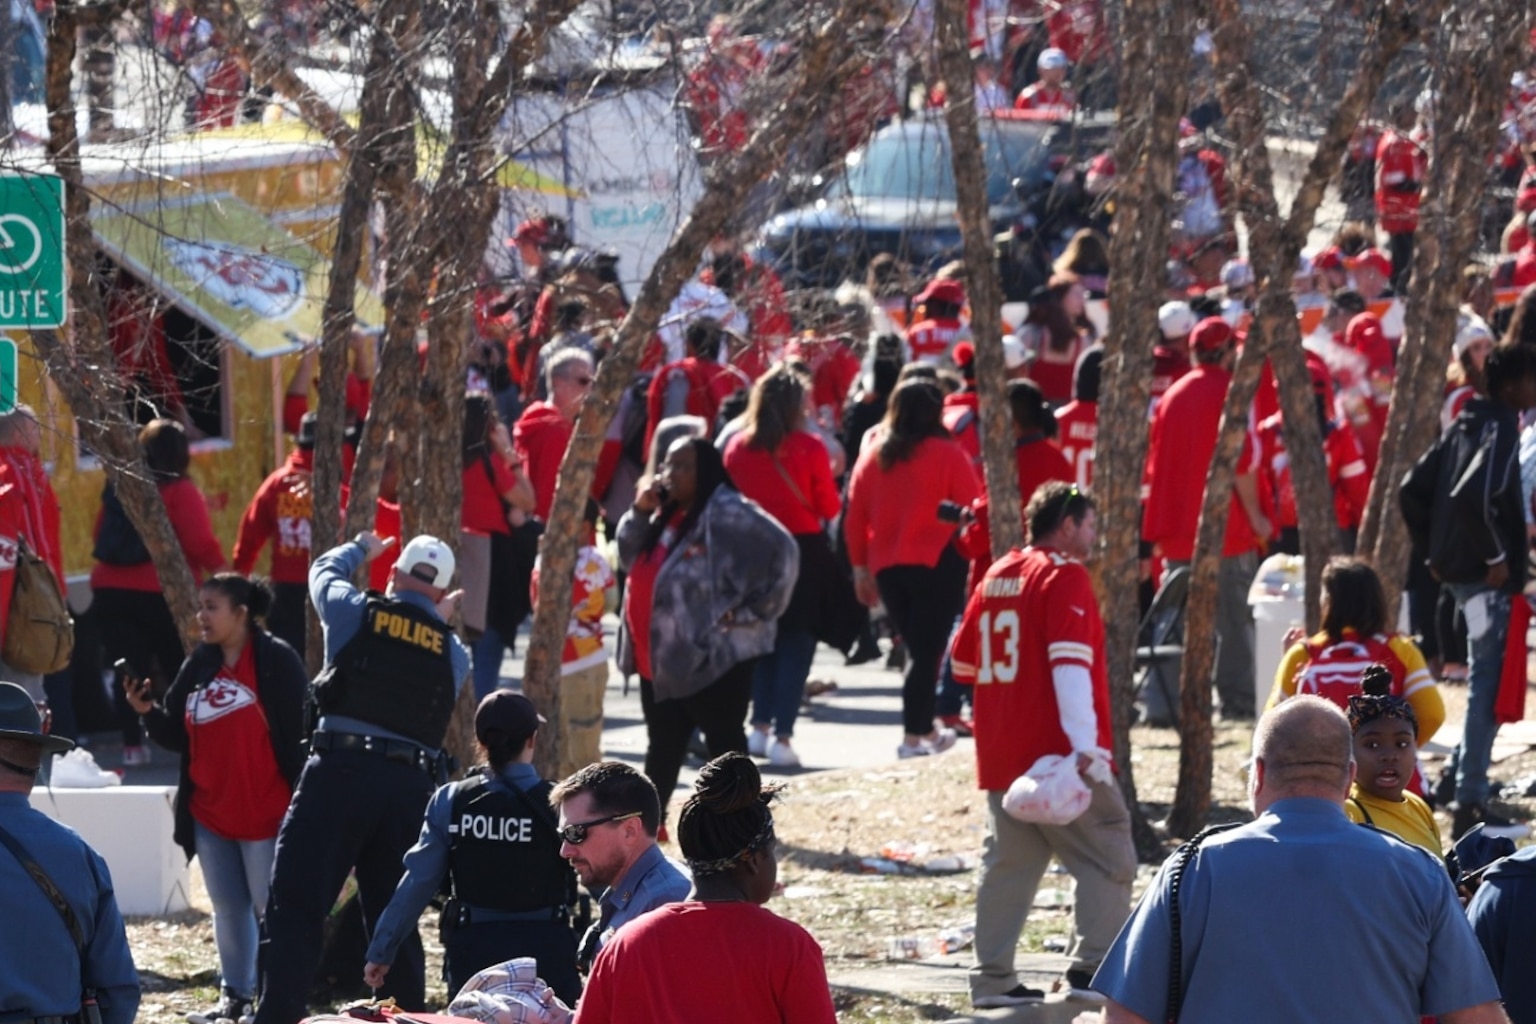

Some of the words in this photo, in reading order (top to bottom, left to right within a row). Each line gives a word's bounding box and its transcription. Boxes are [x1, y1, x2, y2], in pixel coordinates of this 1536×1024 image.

[374, 611, 443, 655] POLICE
[977, 609, 1020, 684] 13
[461, 813, 532, 843] POLICE
